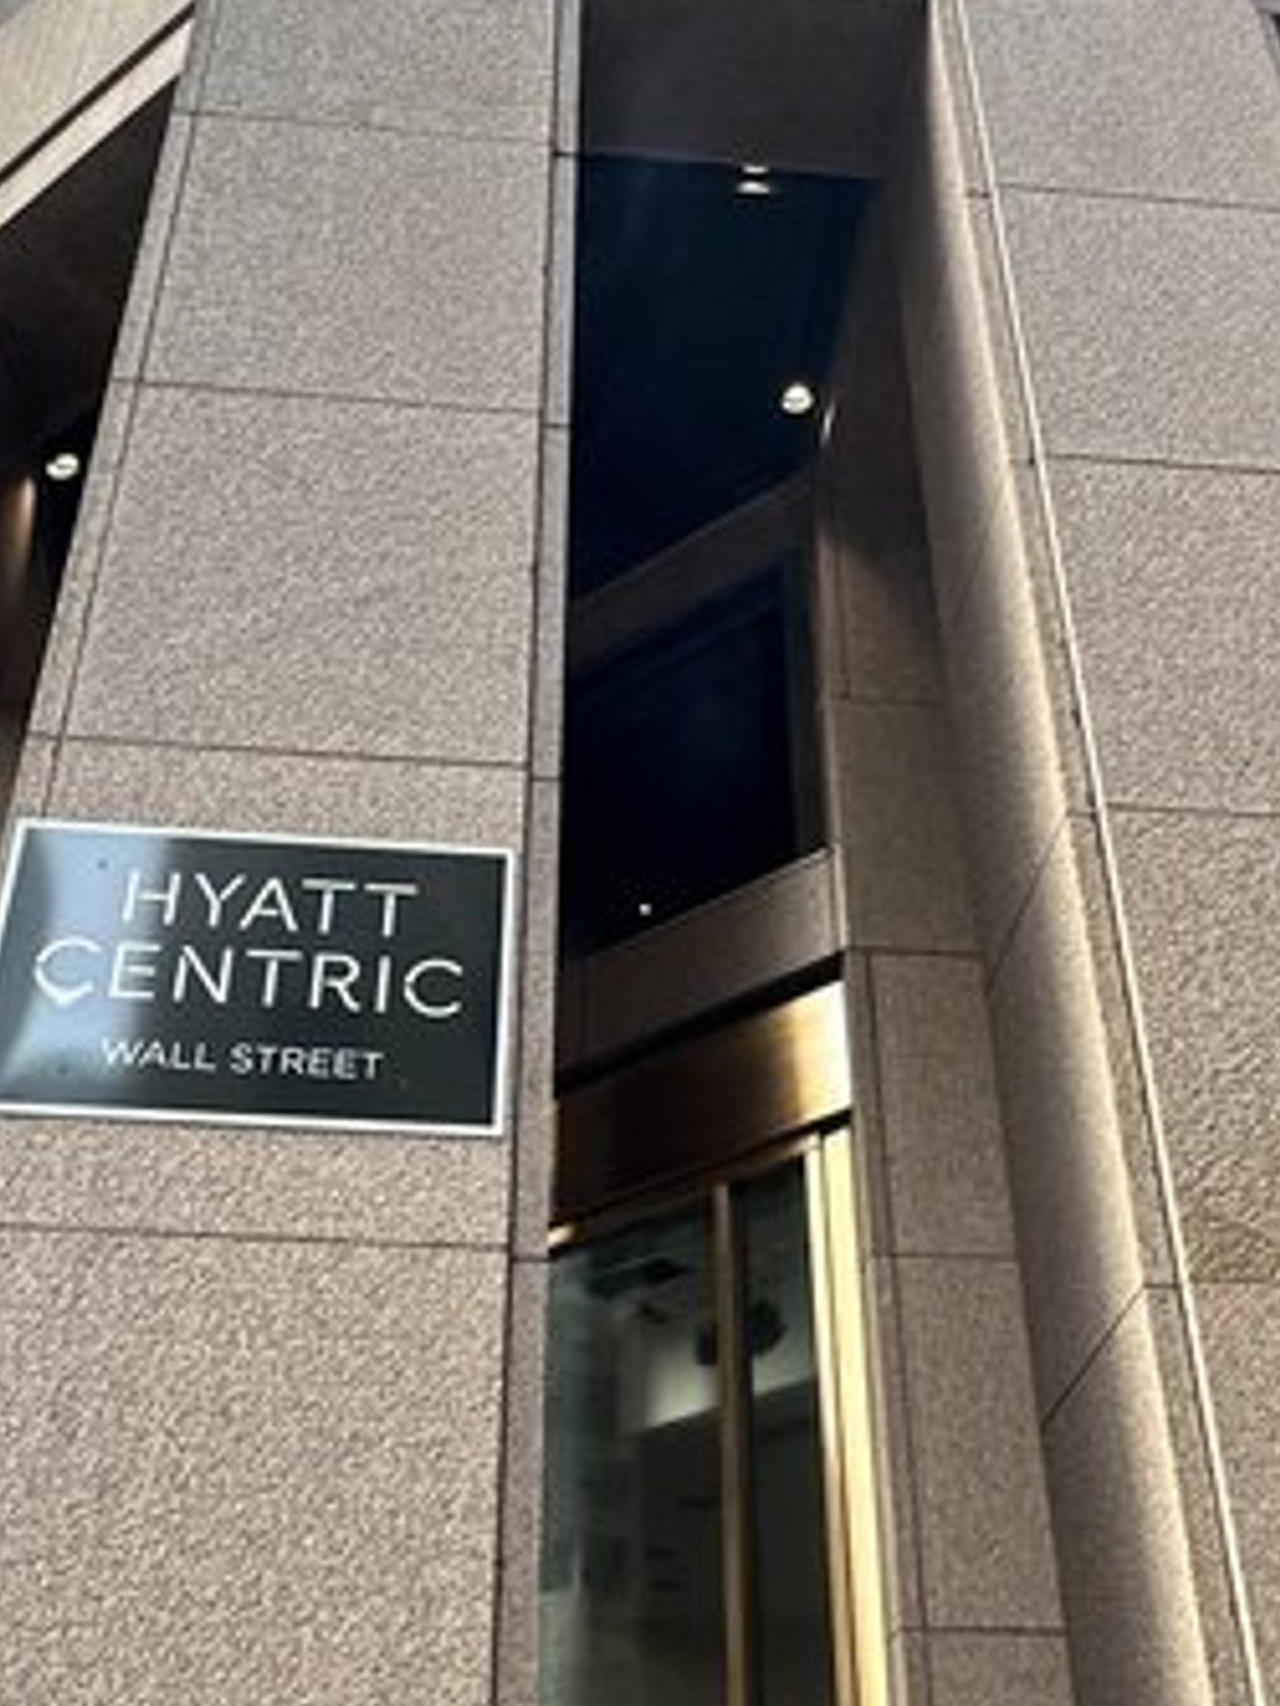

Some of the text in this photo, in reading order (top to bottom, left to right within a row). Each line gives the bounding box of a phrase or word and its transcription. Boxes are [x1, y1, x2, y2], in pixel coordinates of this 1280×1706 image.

[122, 872, 417, 938] HYATT
[35, 936, 464, 1017] CENTRIC
[103, 1039, 385, 1080] WALL STREET
